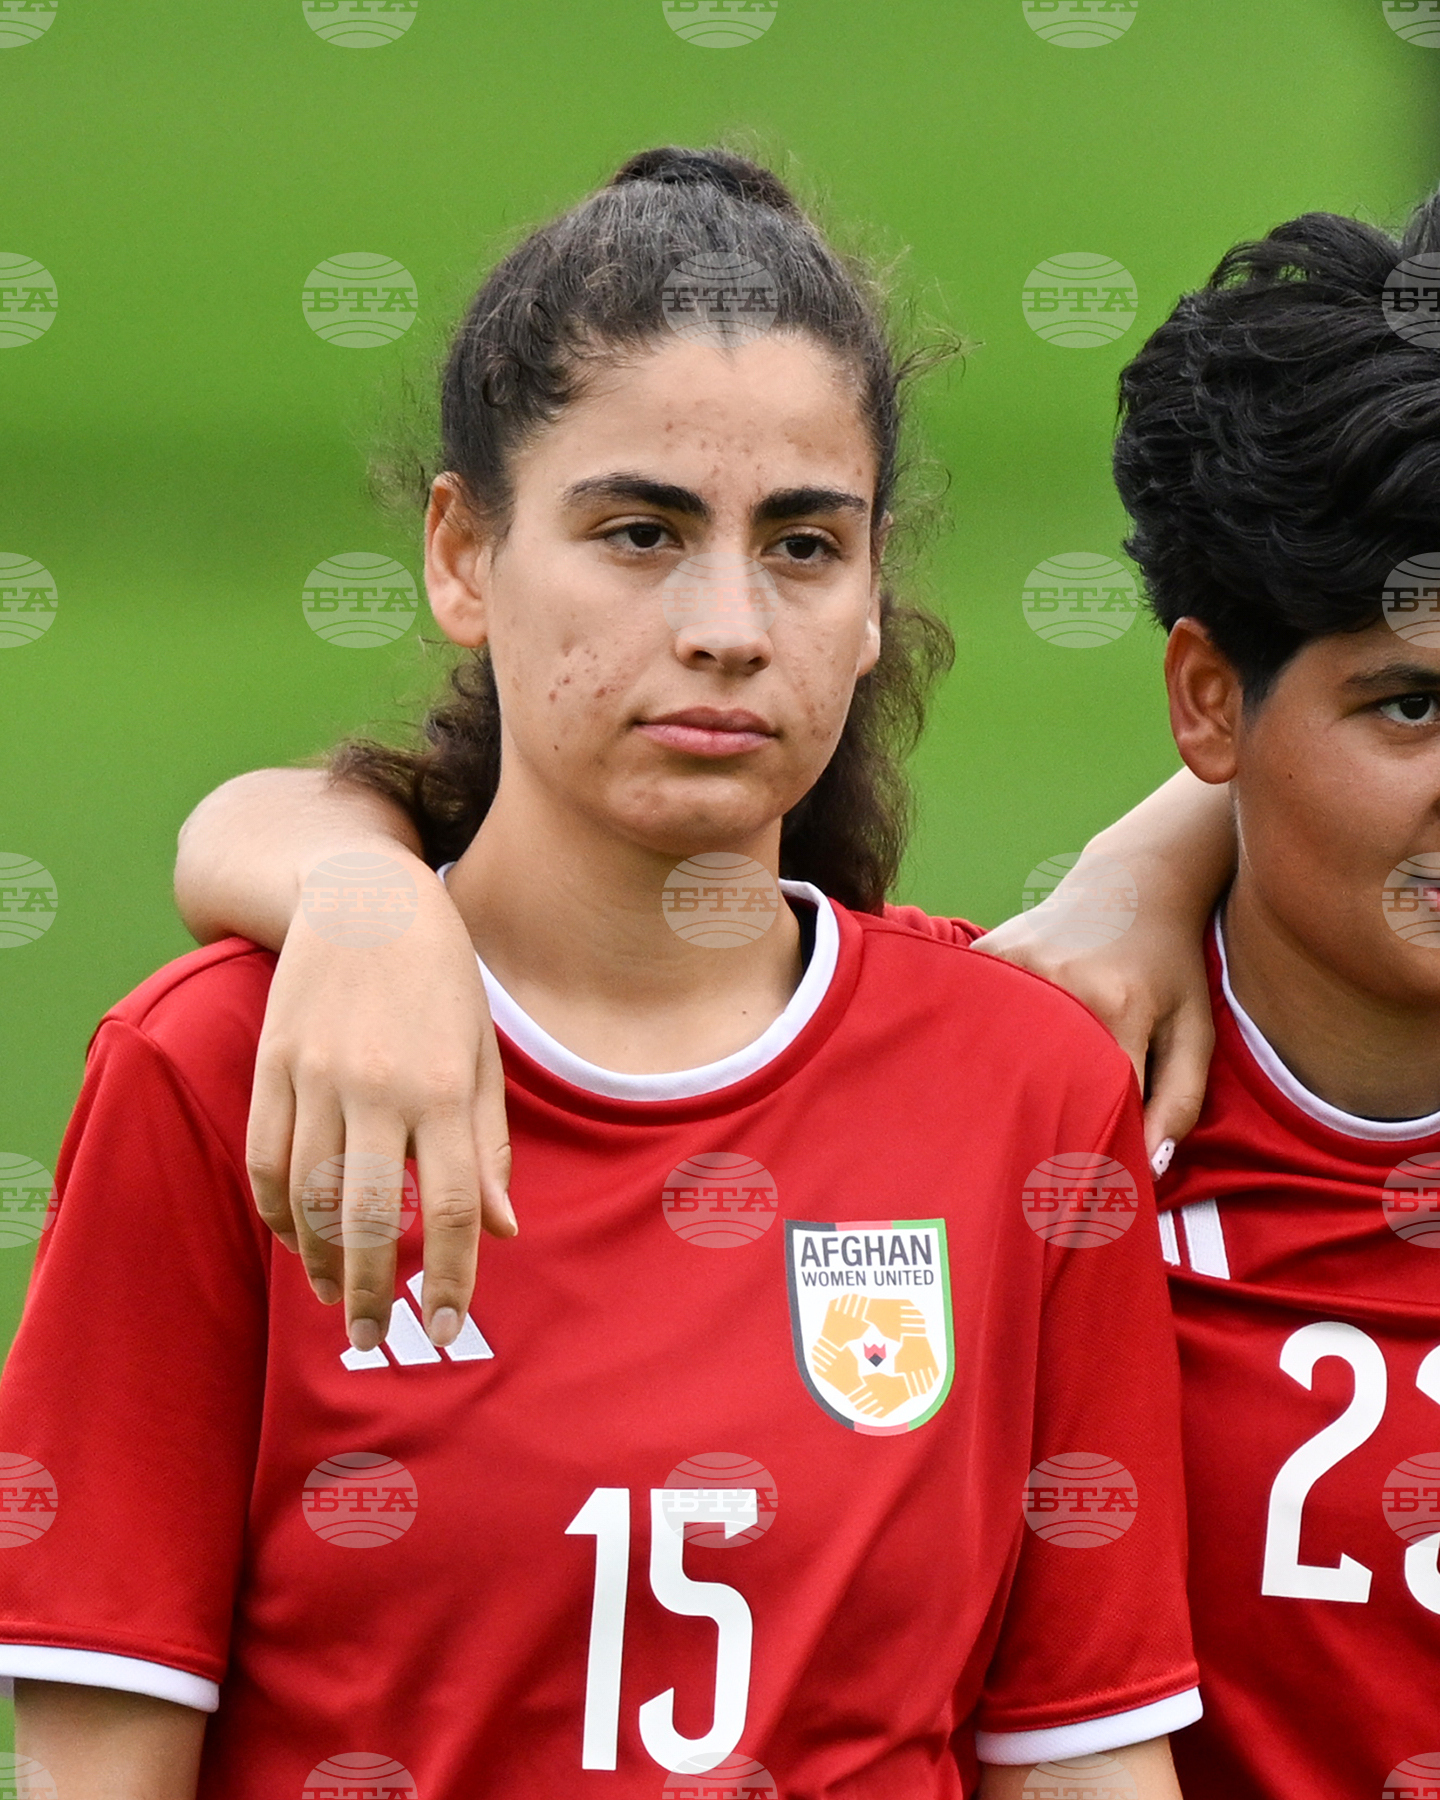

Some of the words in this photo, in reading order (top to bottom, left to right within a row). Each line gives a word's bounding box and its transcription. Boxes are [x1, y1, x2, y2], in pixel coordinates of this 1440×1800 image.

[800, 1234, 933, 1268] AFGHAN
[801, 1270, 867, 1287] WOMEN
[874, 1269, 934, 1286] UNITED
[565, 1488, 758, 1774] 15
